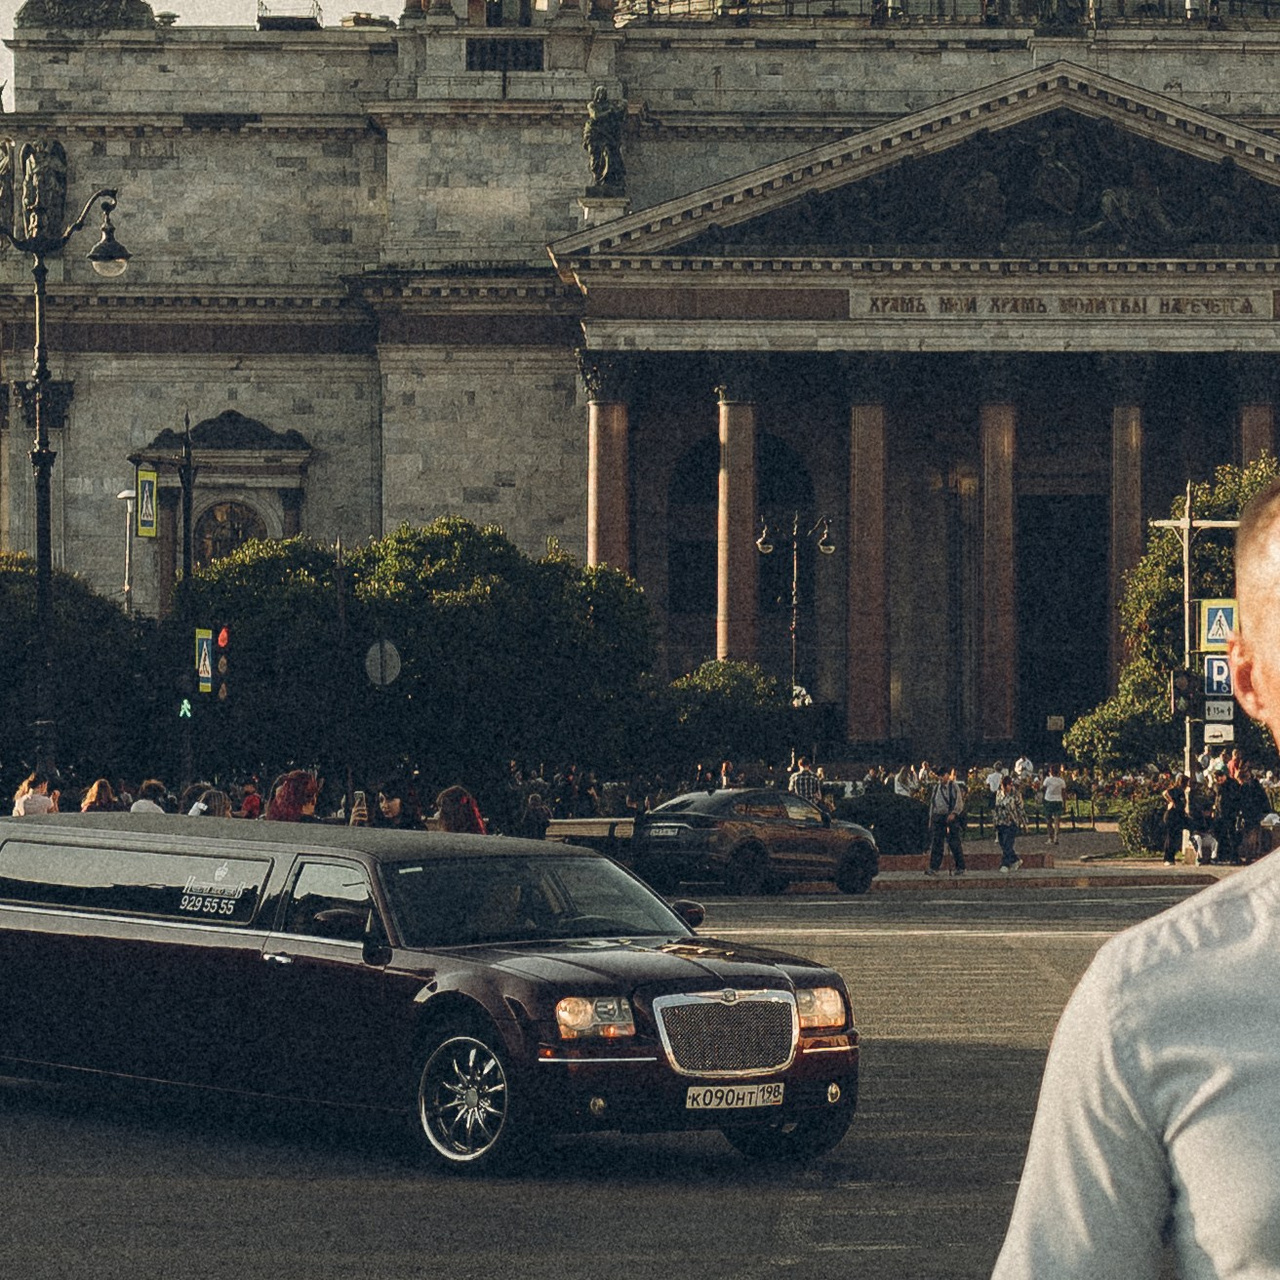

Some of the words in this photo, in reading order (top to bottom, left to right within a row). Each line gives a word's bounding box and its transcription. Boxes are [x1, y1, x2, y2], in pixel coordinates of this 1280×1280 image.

[869, 296, 927, 313] ХРАМЪ
[989, 296, 1047, 313] ХРАМЪ
[1213, 660, 1229, 691] P
[180, 895, 203, 911] 929
[203, 898, 219, 913] 55
[219, 900, 236, 915] 55
[691, 1088, 756, 1107] К090НТ
[759, 1084, 781, 1100] 198
